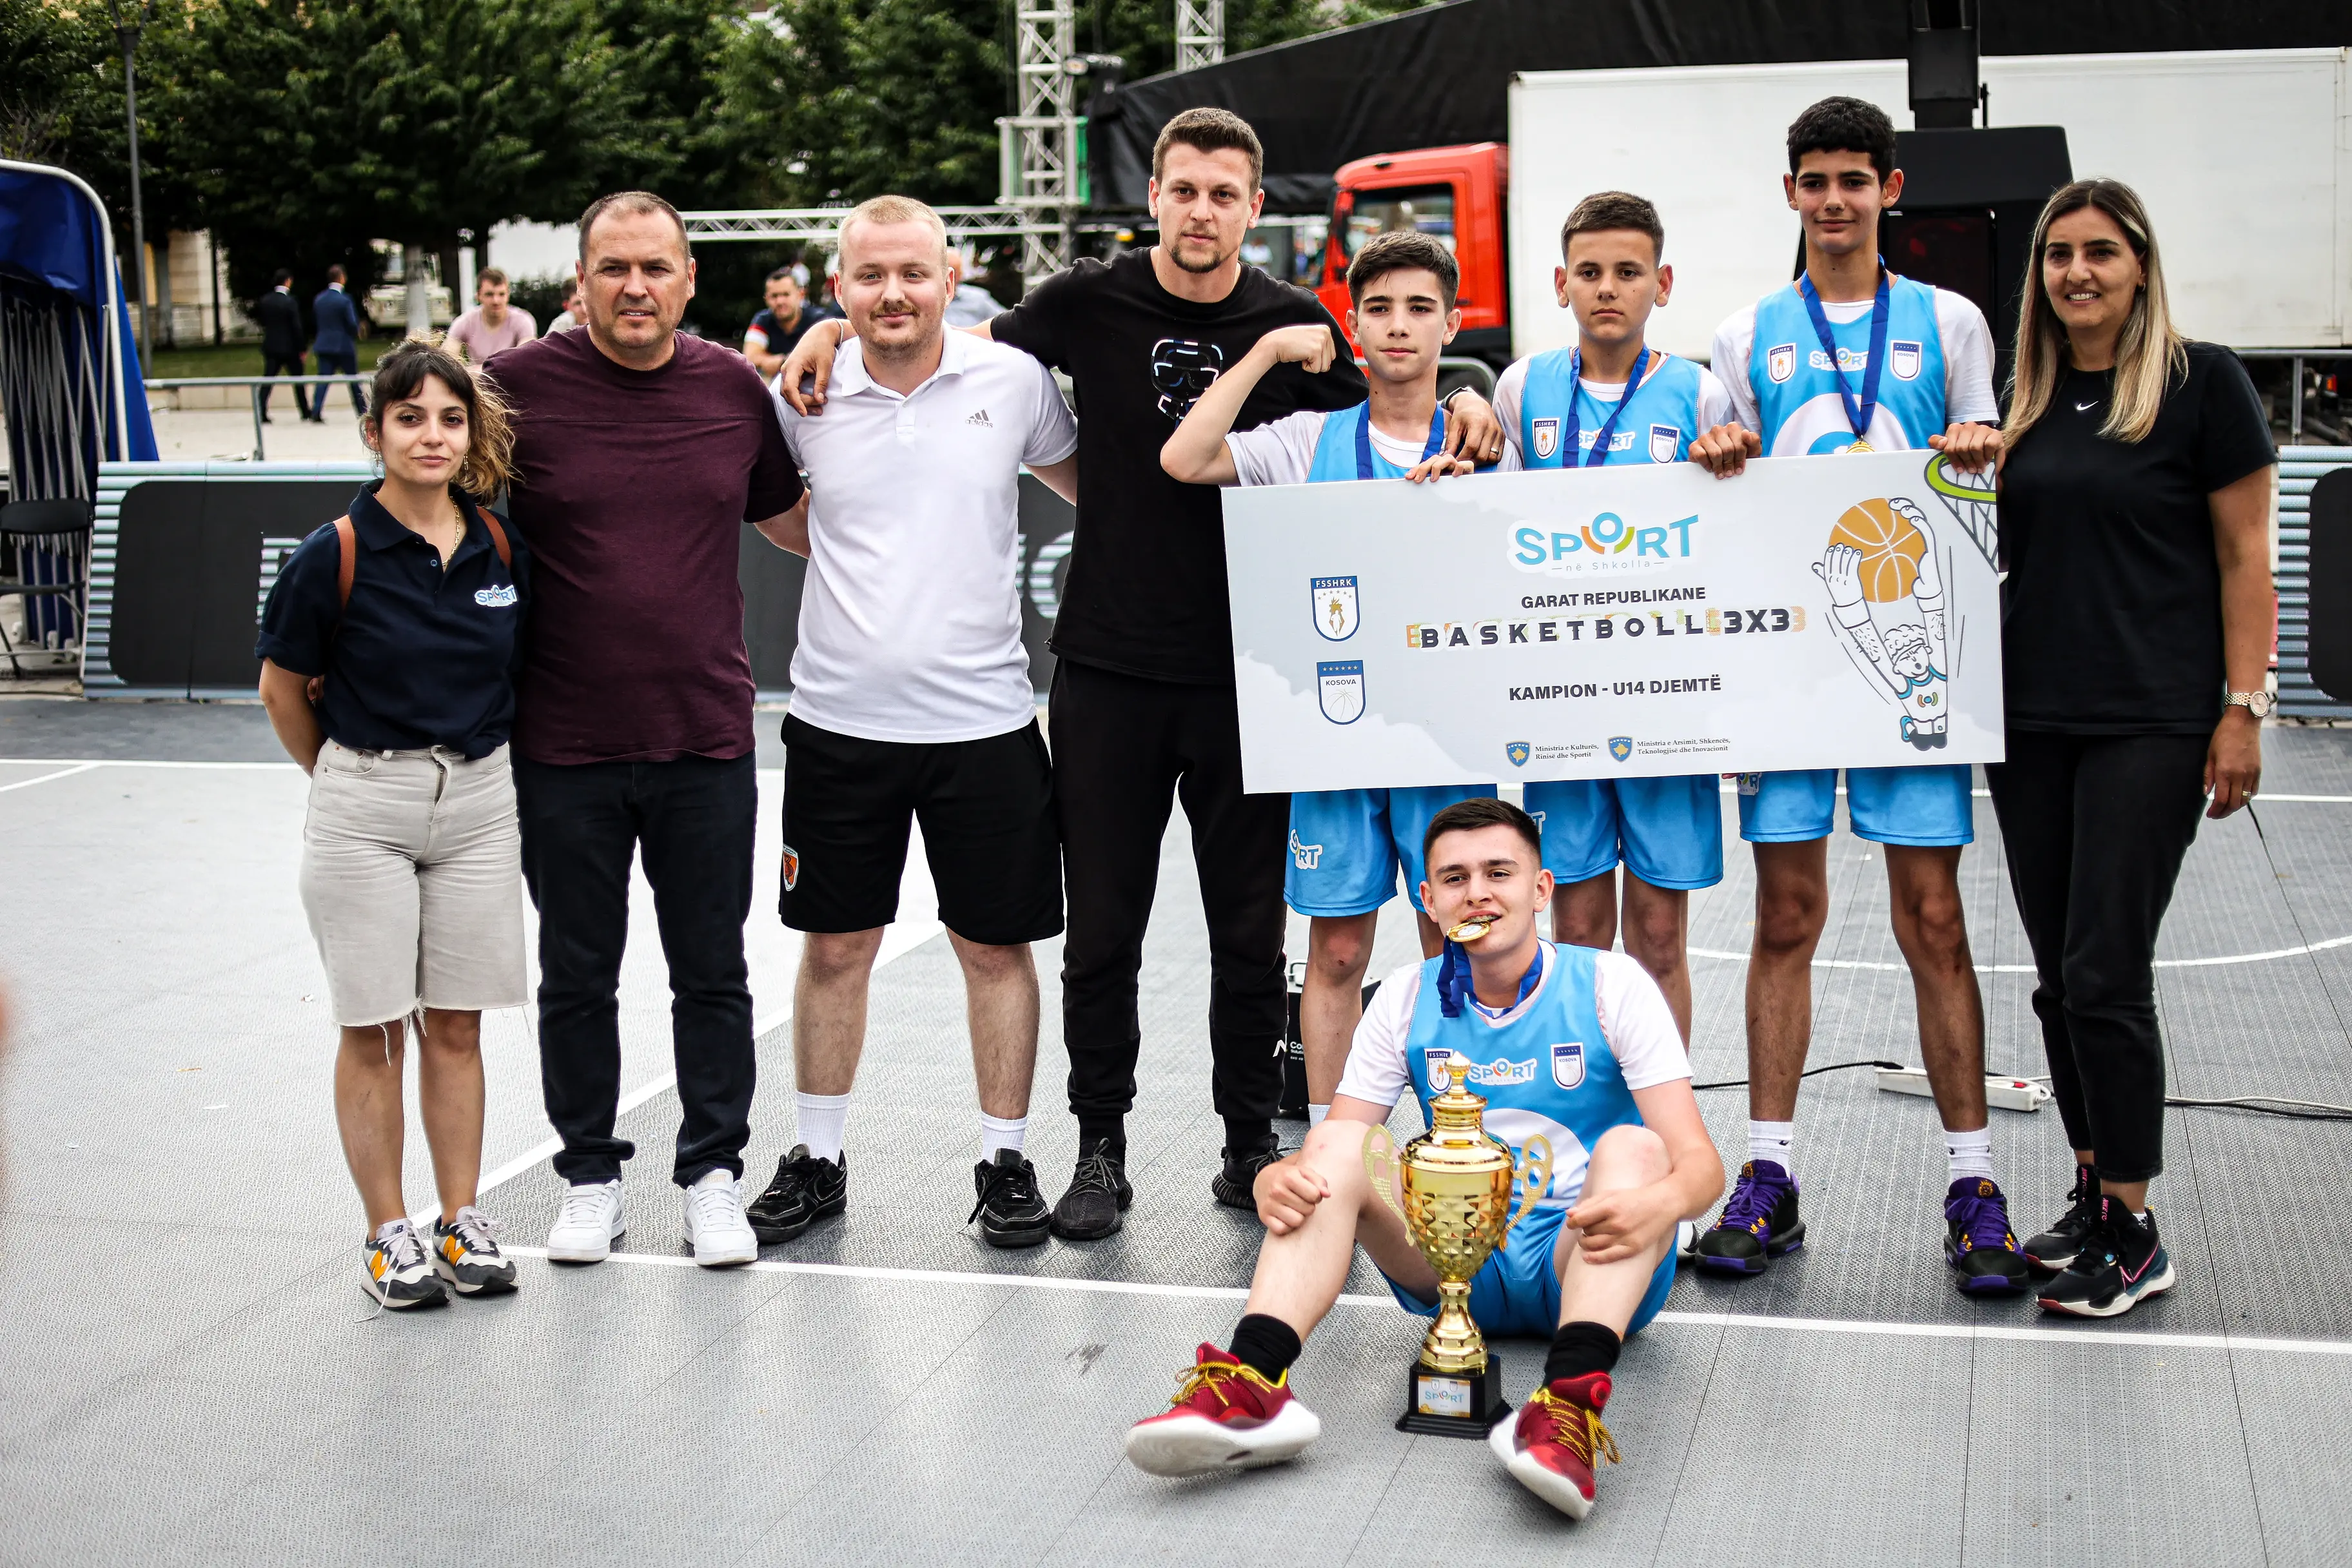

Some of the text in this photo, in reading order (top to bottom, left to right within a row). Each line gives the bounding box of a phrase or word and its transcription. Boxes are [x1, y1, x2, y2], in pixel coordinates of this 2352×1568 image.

[965, 418, 994, 427] adidas
[1515, 512, 1699, 565] SPORT
[1566, 560, 1650, 572] në Shkolla
[1315, 578, 1352, 587] FSSHRK
[477, 587, 516, 603] SPORT
[1521, 587, 1706, 609] GARAT REPUBLIKANE
[1420, 614, 1703, 648] BASKETBOLL
[1509, 683, 1597, 701] KAMPION
[1613, 681, 1645, 696] U14
[1650, 674, 1721, 694] DJEMTË
[1570, 751, 1591, 760] Sportit
[1637, 746, 1678, 756] Teknologjisë
[1470, 1061, 1534, 1080] SPORT
[1425, 1390, 1464, 1403] SPORT
